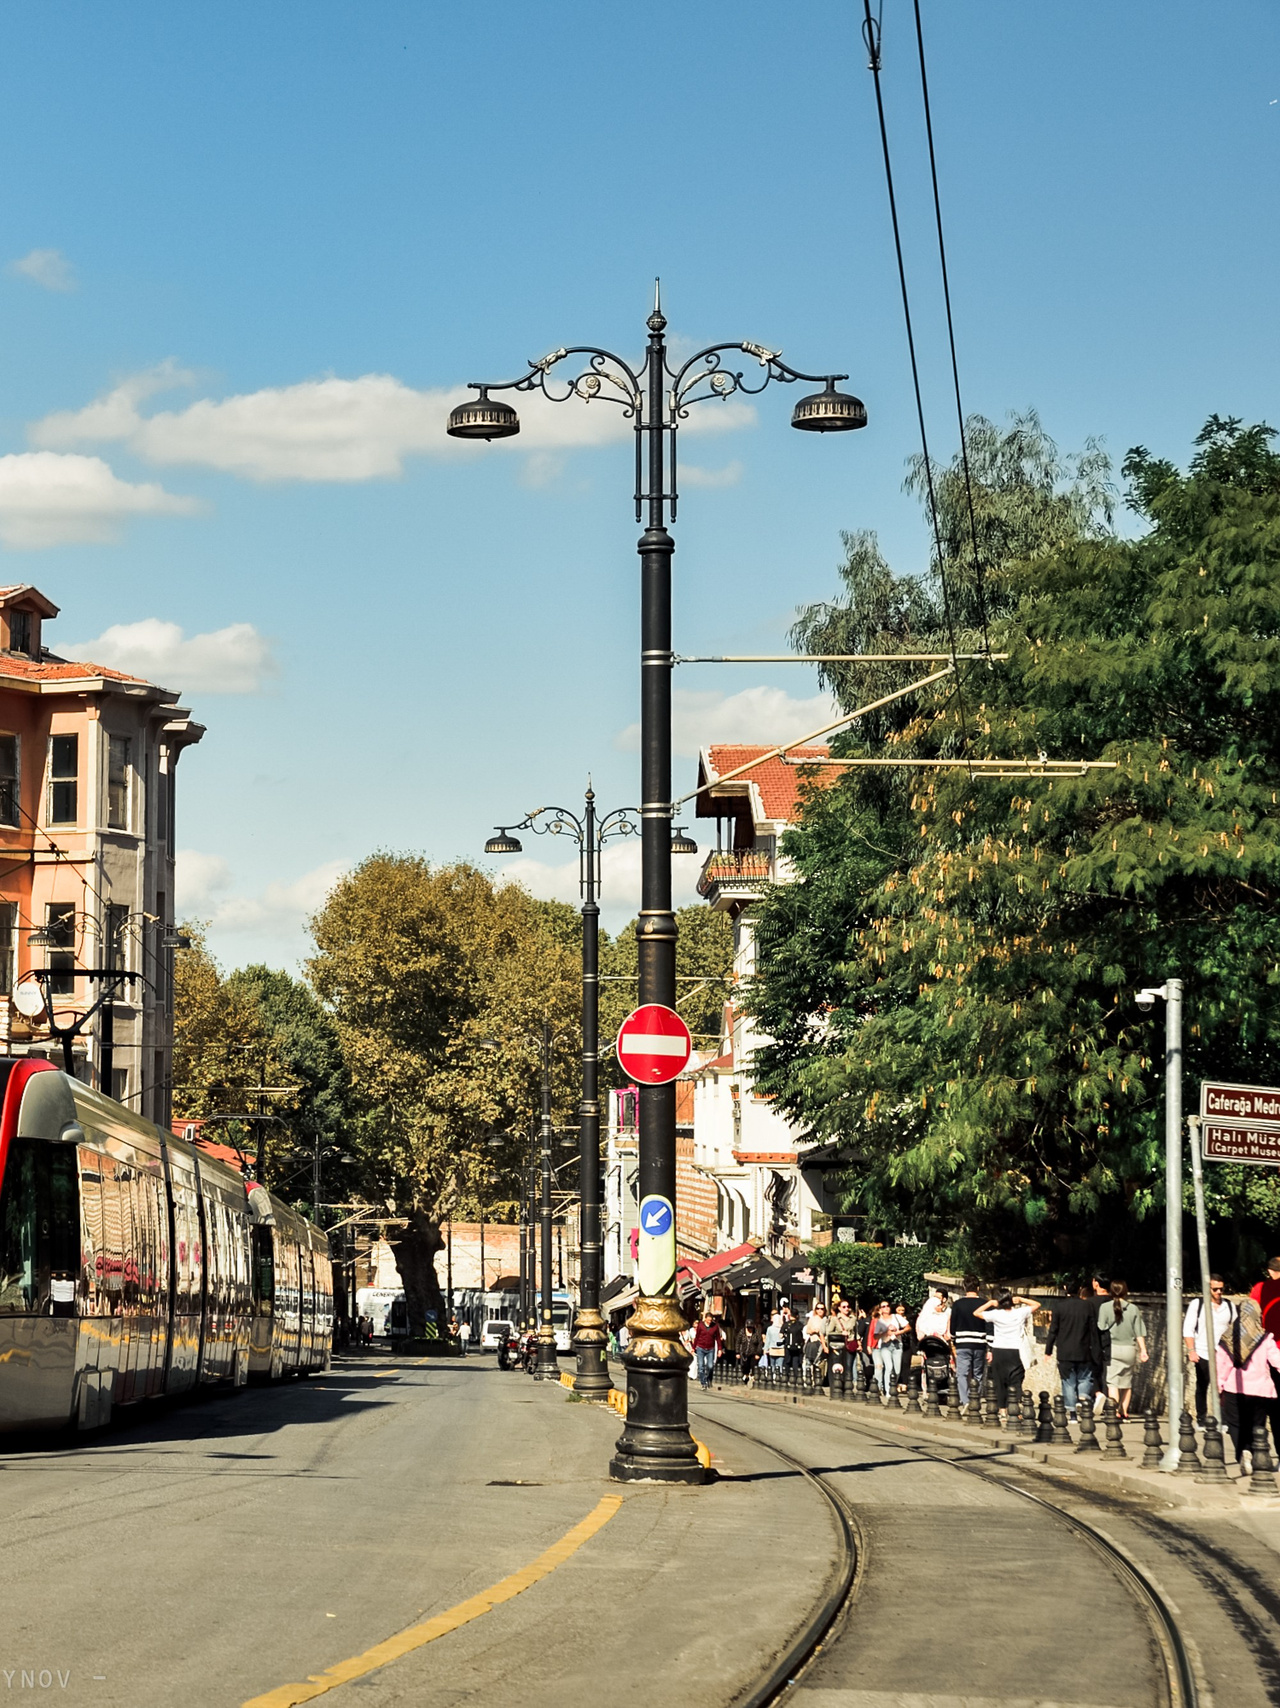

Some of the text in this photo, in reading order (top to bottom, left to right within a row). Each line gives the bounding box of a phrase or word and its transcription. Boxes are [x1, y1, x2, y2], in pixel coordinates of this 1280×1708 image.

[1208, 1092, 1280, 1116] Caferağa Medr
[1212, 1129, 1241, 1142] Halı
[1211, 1141, 1248, 1156] (Carpet
